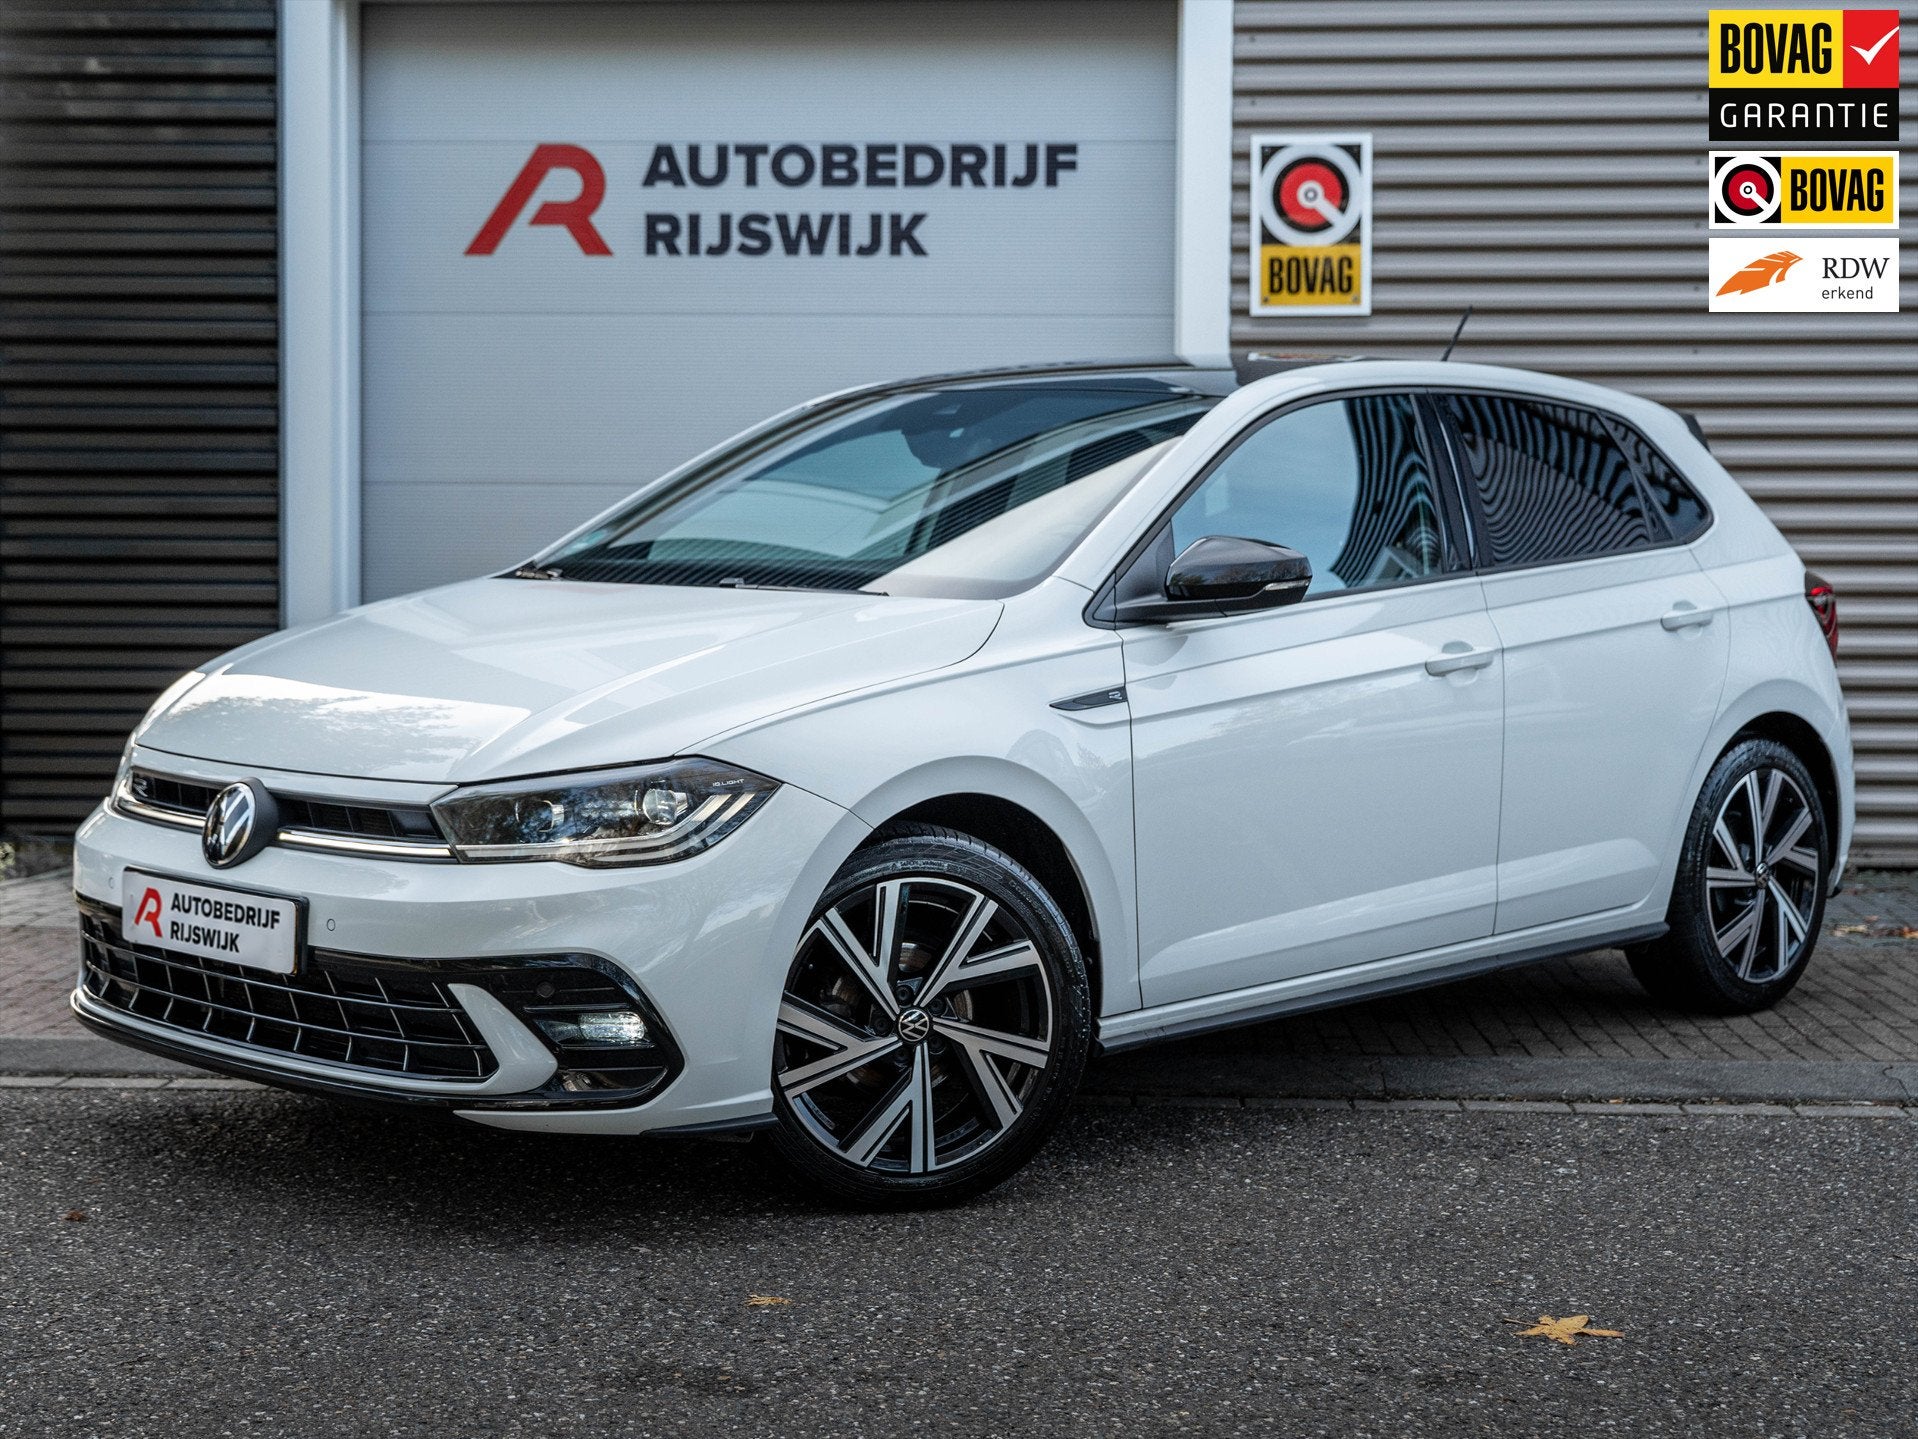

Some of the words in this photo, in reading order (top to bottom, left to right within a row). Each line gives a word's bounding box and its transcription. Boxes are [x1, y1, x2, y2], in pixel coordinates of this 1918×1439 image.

[642, 143, 1078, 188] AUTOBEDRIJF
[644, 213, 928, 257] RIJSWIJK
[1268, 255, 1354, 294] BOVAG
[171, 892, 280, 930] AUTOBEDRIJF
[170, 921, 240, 953] RIJSWIJK
